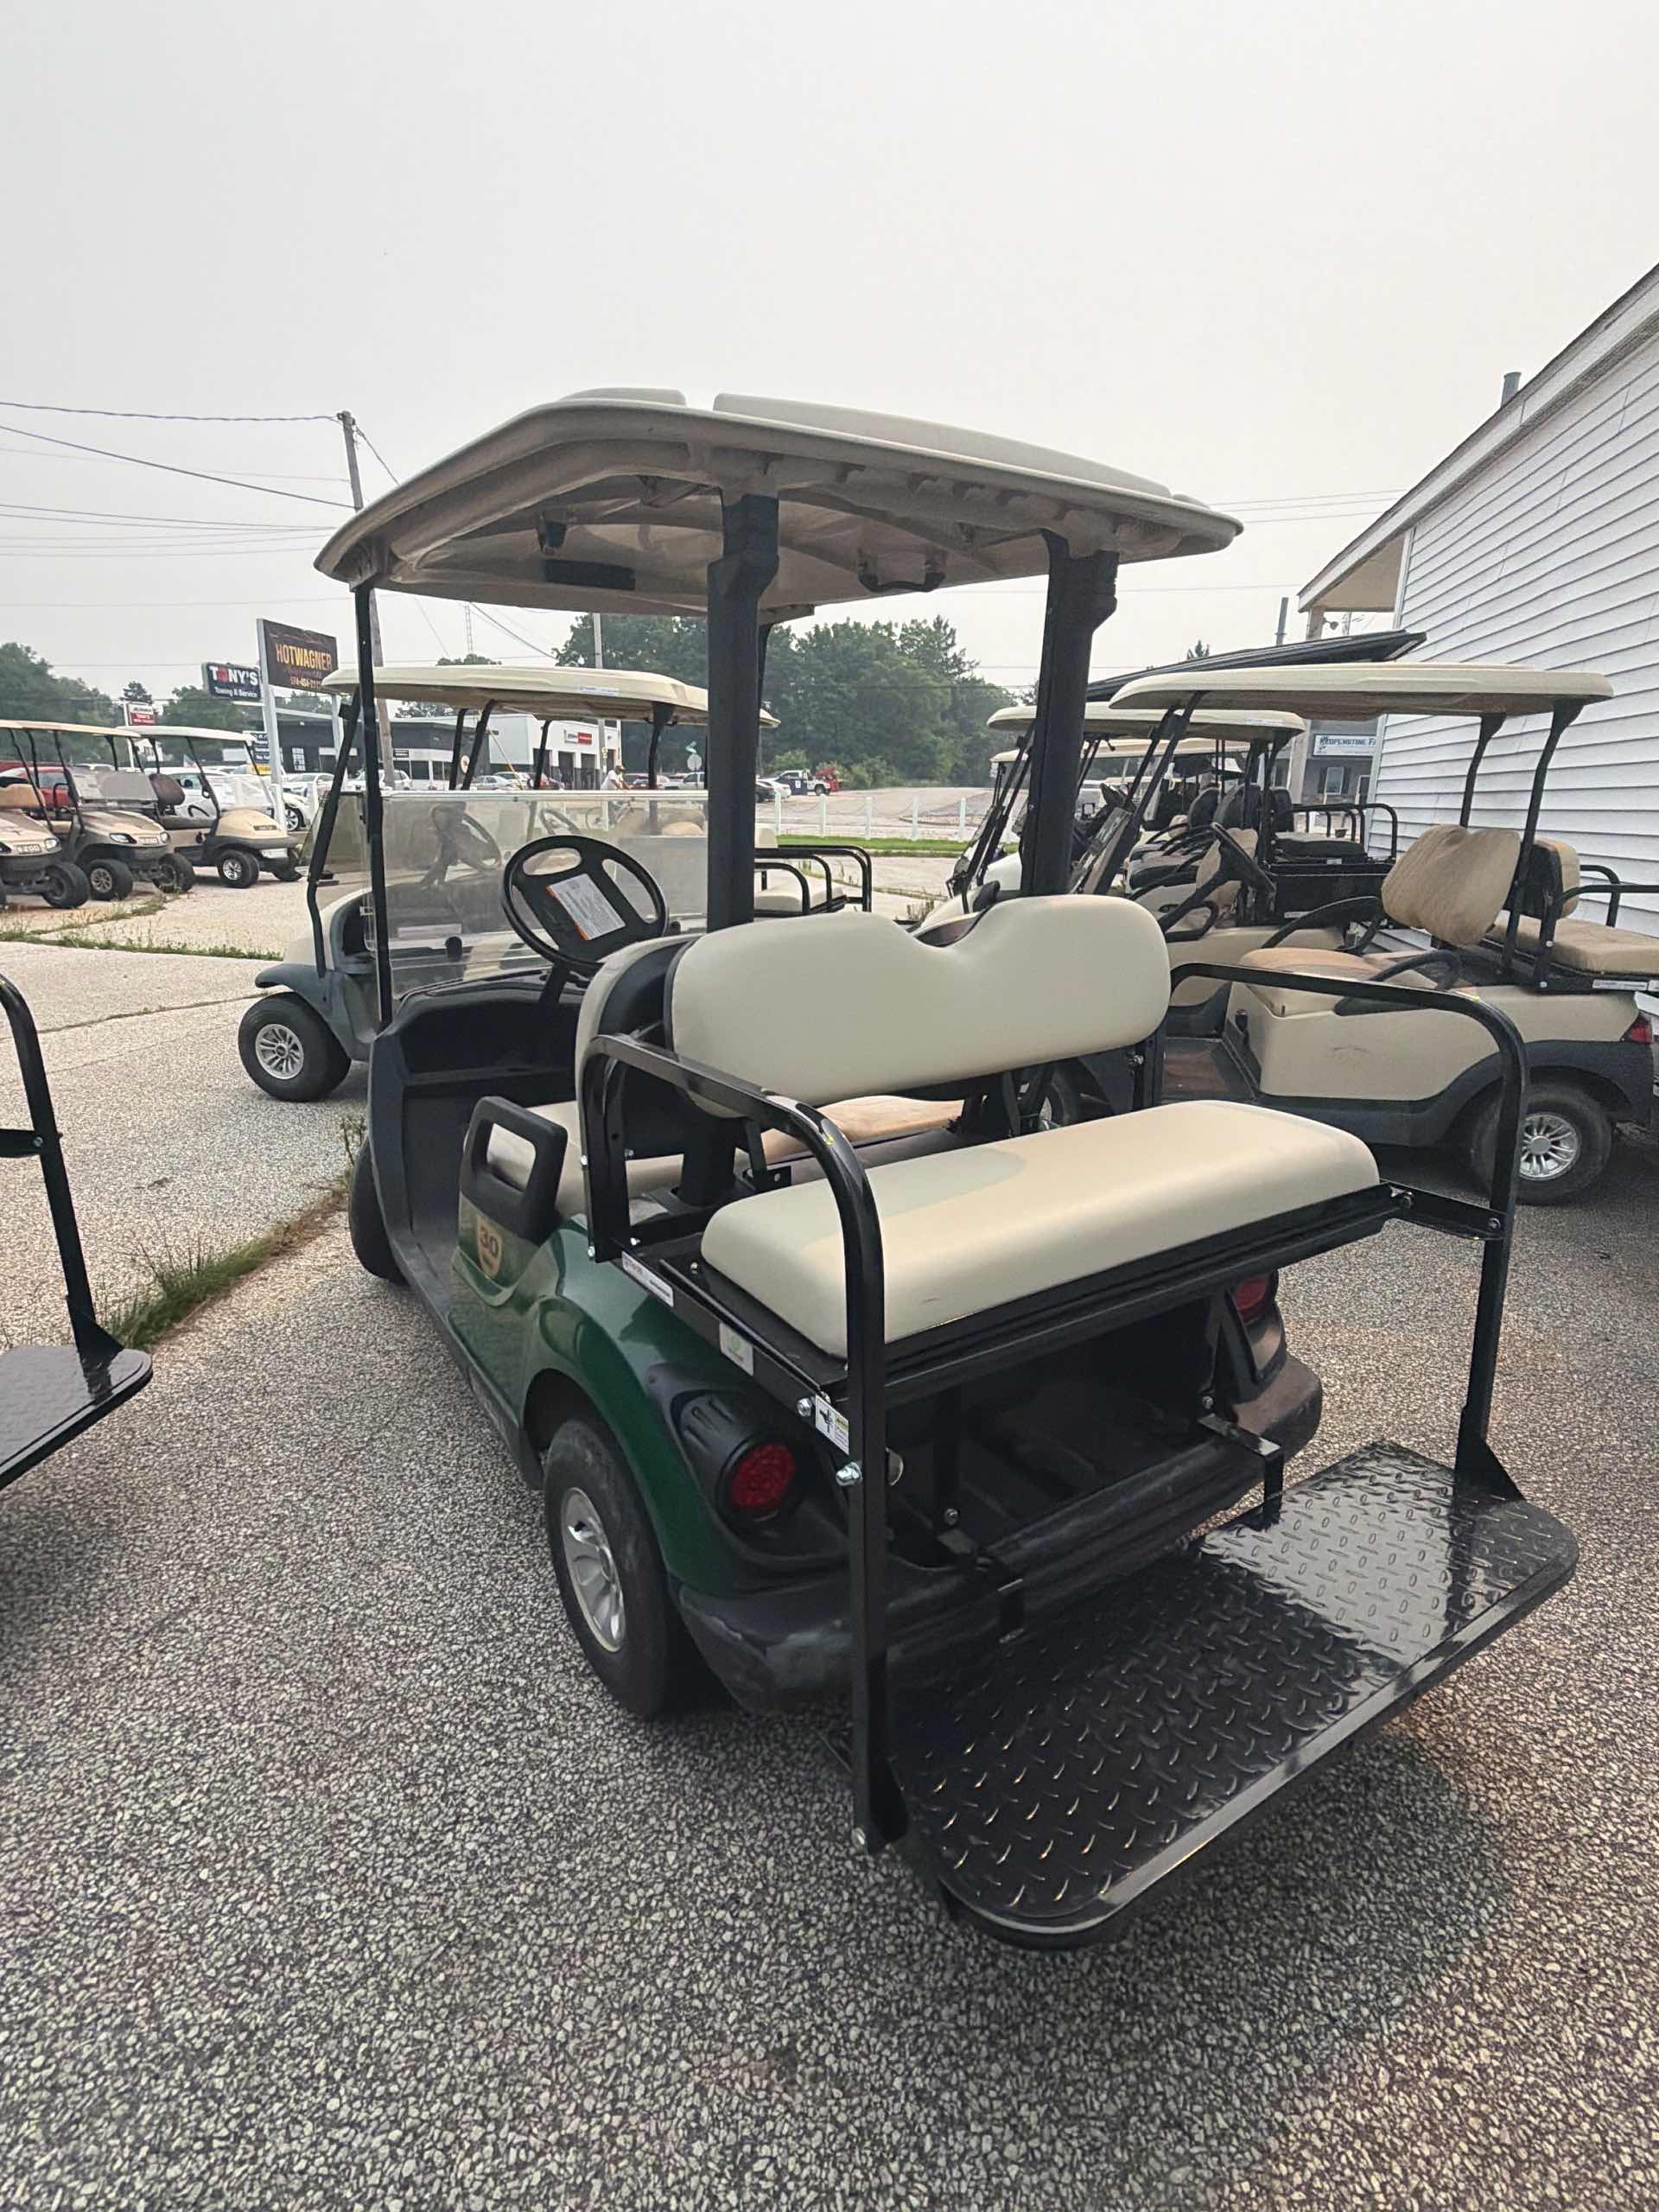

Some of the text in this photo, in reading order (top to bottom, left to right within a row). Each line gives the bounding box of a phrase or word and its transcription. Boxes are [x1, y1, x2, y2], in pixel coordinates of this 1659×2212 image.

[276, 643, 332, 671] HOTWAGNER
[209, 665, 258, 686] TONY'S
[480, 1226, 499, 1258] 30
